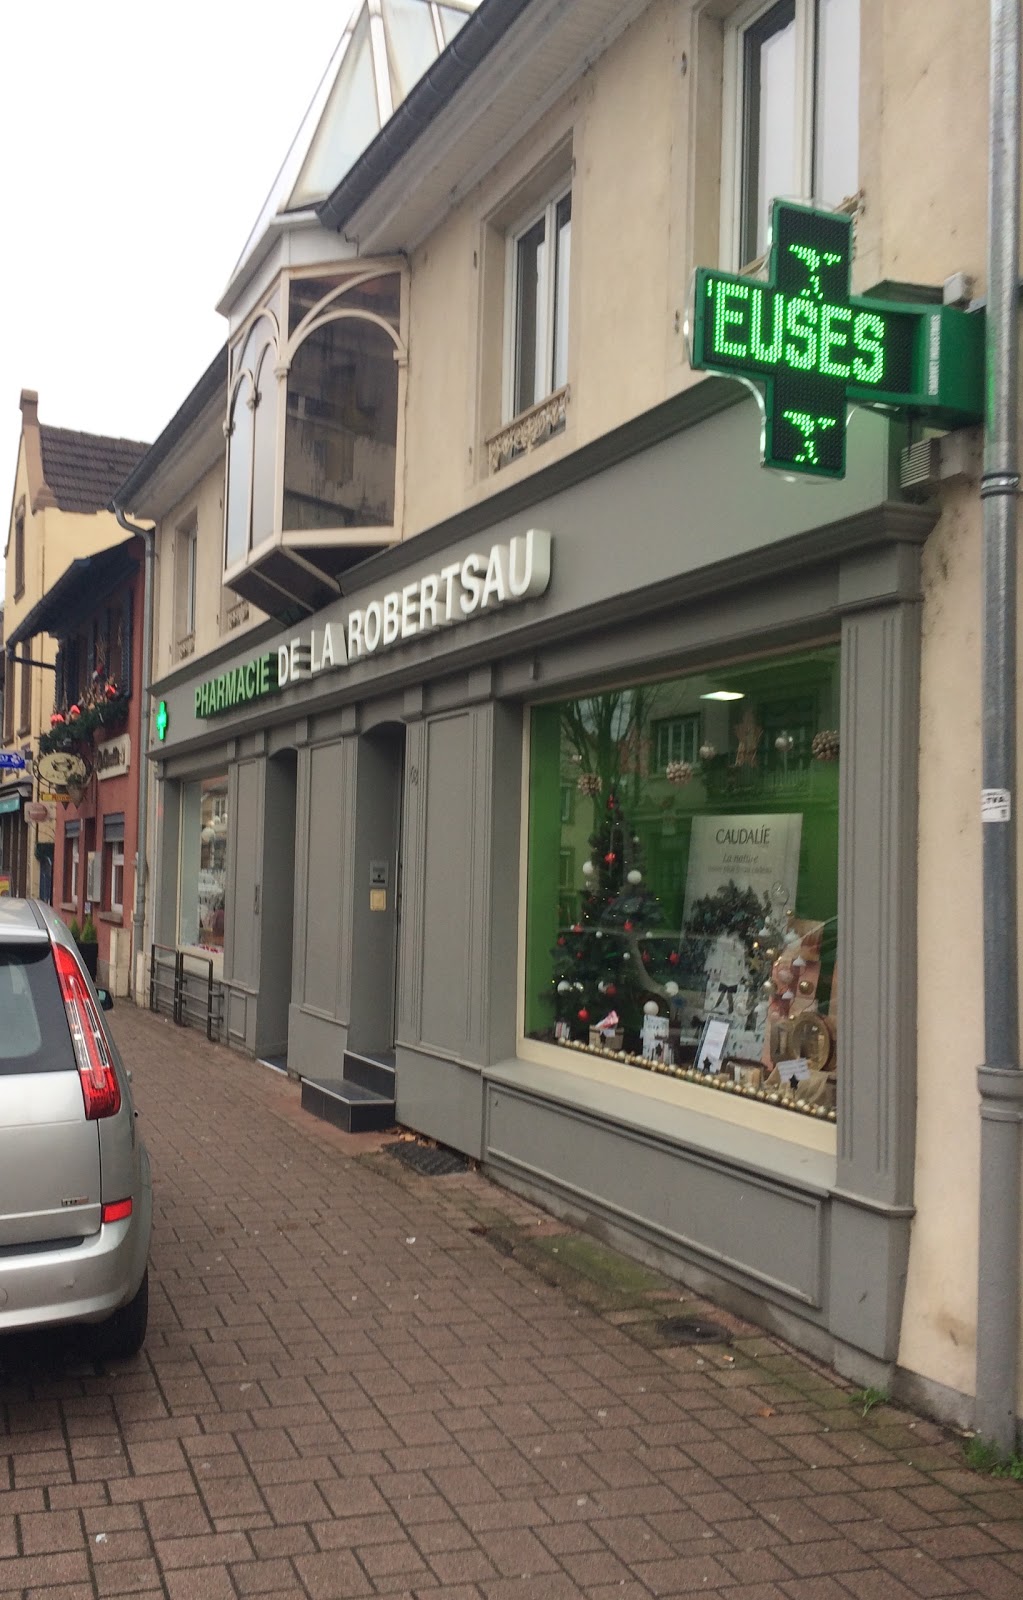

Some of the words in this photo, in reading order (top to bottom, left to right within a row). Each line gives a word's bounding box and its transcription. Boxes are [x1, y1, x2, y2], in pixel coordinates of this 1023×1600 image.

[706, 279, 885, 384] EUSES
[194, 653, 274, 719] PHARMACIE
[277, 637, 303, 687] DE
[311, 622, 338, 672] LA
[348, 528, 552, 661] ROBERTSAU
